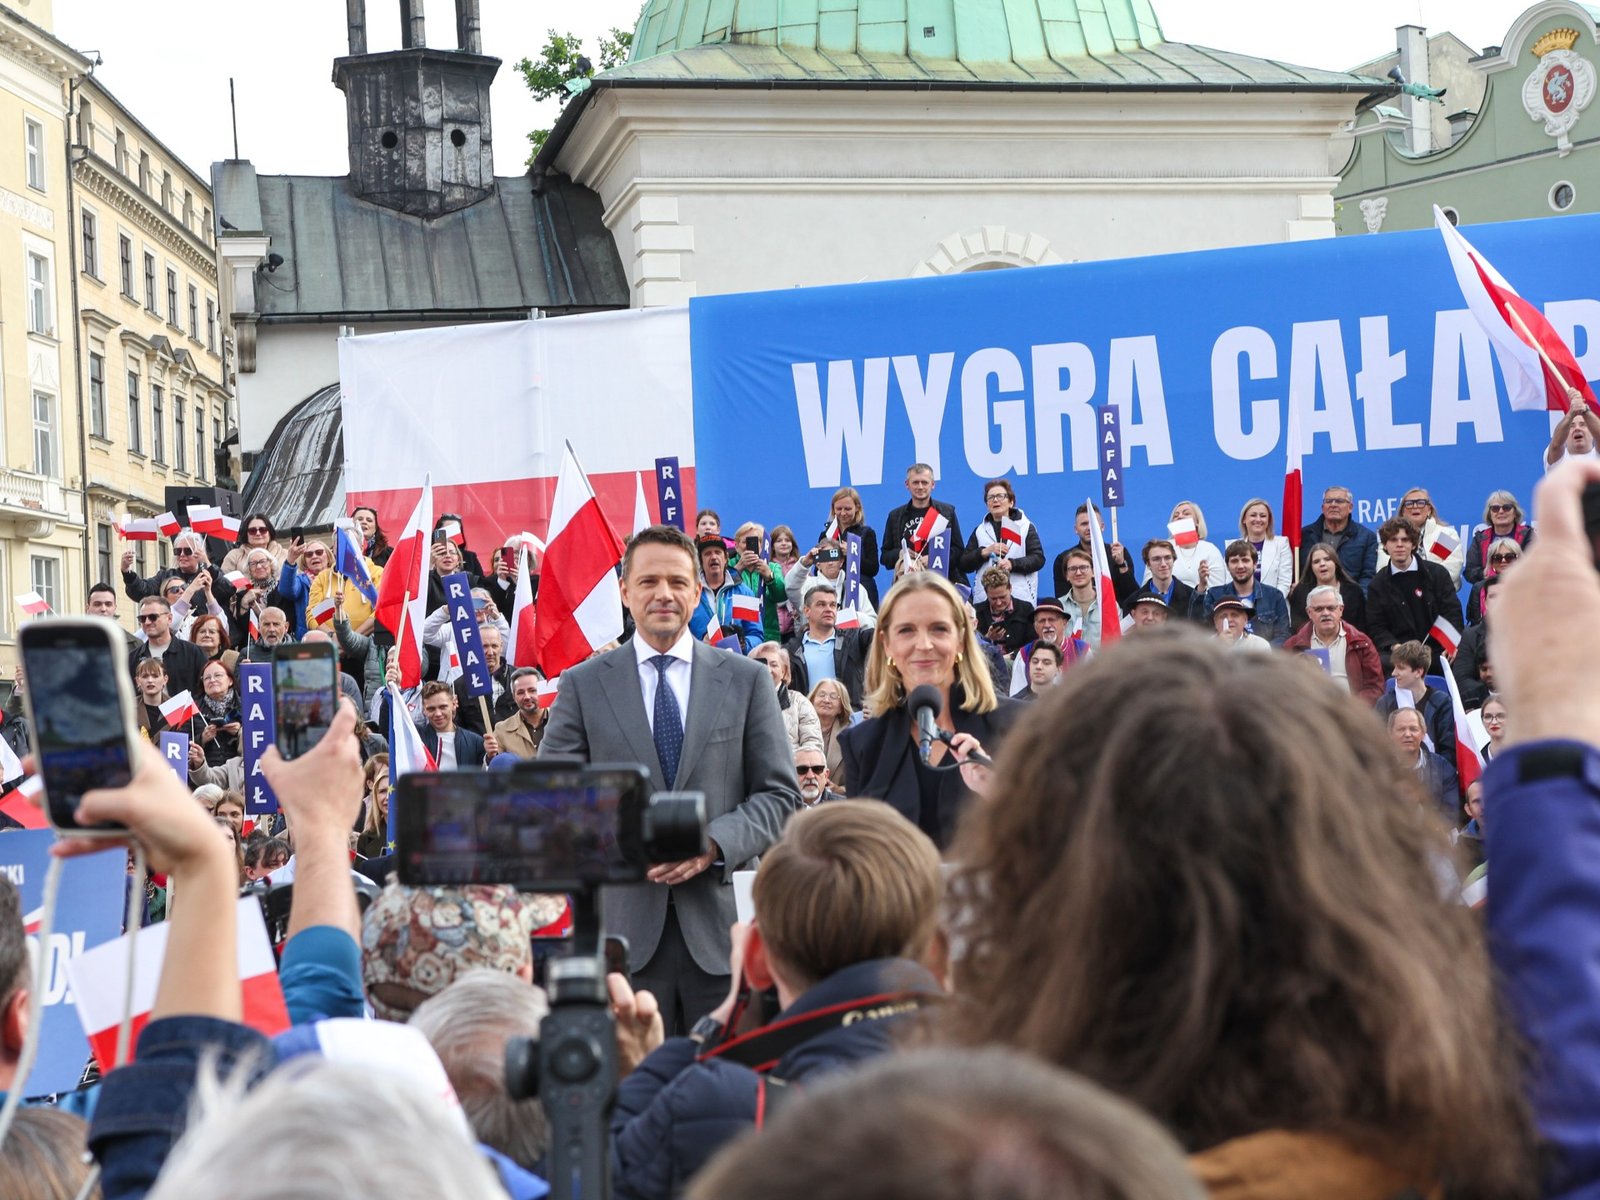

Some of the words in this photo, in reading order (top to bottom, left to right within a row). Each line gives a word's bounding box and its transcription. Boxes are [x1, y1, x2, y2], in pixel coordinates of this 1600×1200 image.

[791, 335, 1174, 489] WYGRA
[1211, 308, 1504, 461] CAŁA
[661, 465, 677, 521] RAF
[1103, 412, 1118, 500] RAFAŁ
[1358, 497, 1400, 524] RAF
[850, 541, 859, 609] RAFA
[449, 583, 484, 688] RAFAŁ
[247, 675, 268, 804] RAFAŁ
